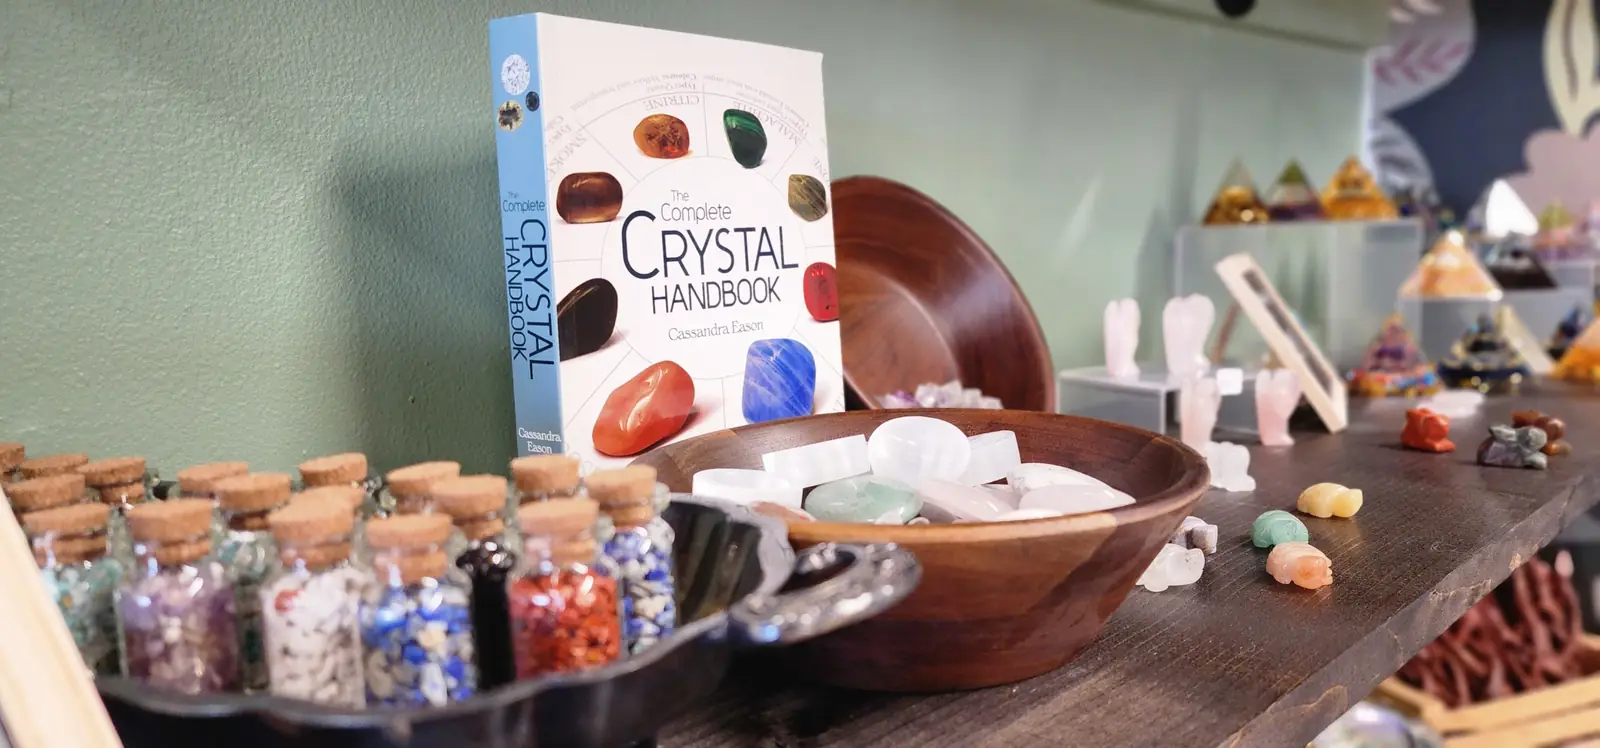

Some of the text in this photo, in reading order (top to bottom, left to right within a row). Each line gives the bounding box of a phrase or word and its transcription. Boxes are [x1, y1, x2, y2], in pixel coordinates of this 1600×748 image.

[642, 94, 700, 111] CITRINE
[502, 199, 546, 214] Complete
[671, 189, 690, 203] The
[660, 202, 732, 225] Complete
[621, 210, 799, 280] CRYSTAL
[505, 237, 528, 361] HANDBOOK
[520, 219, 555, 380] CRYSTAL
[651, 276, 781, 315] HANDBOOK
[668, 319, 764, 342] Cassandra Eason
[518, 427, 562, 443] Cassandra
[527, 441, 553, 455] Eason
